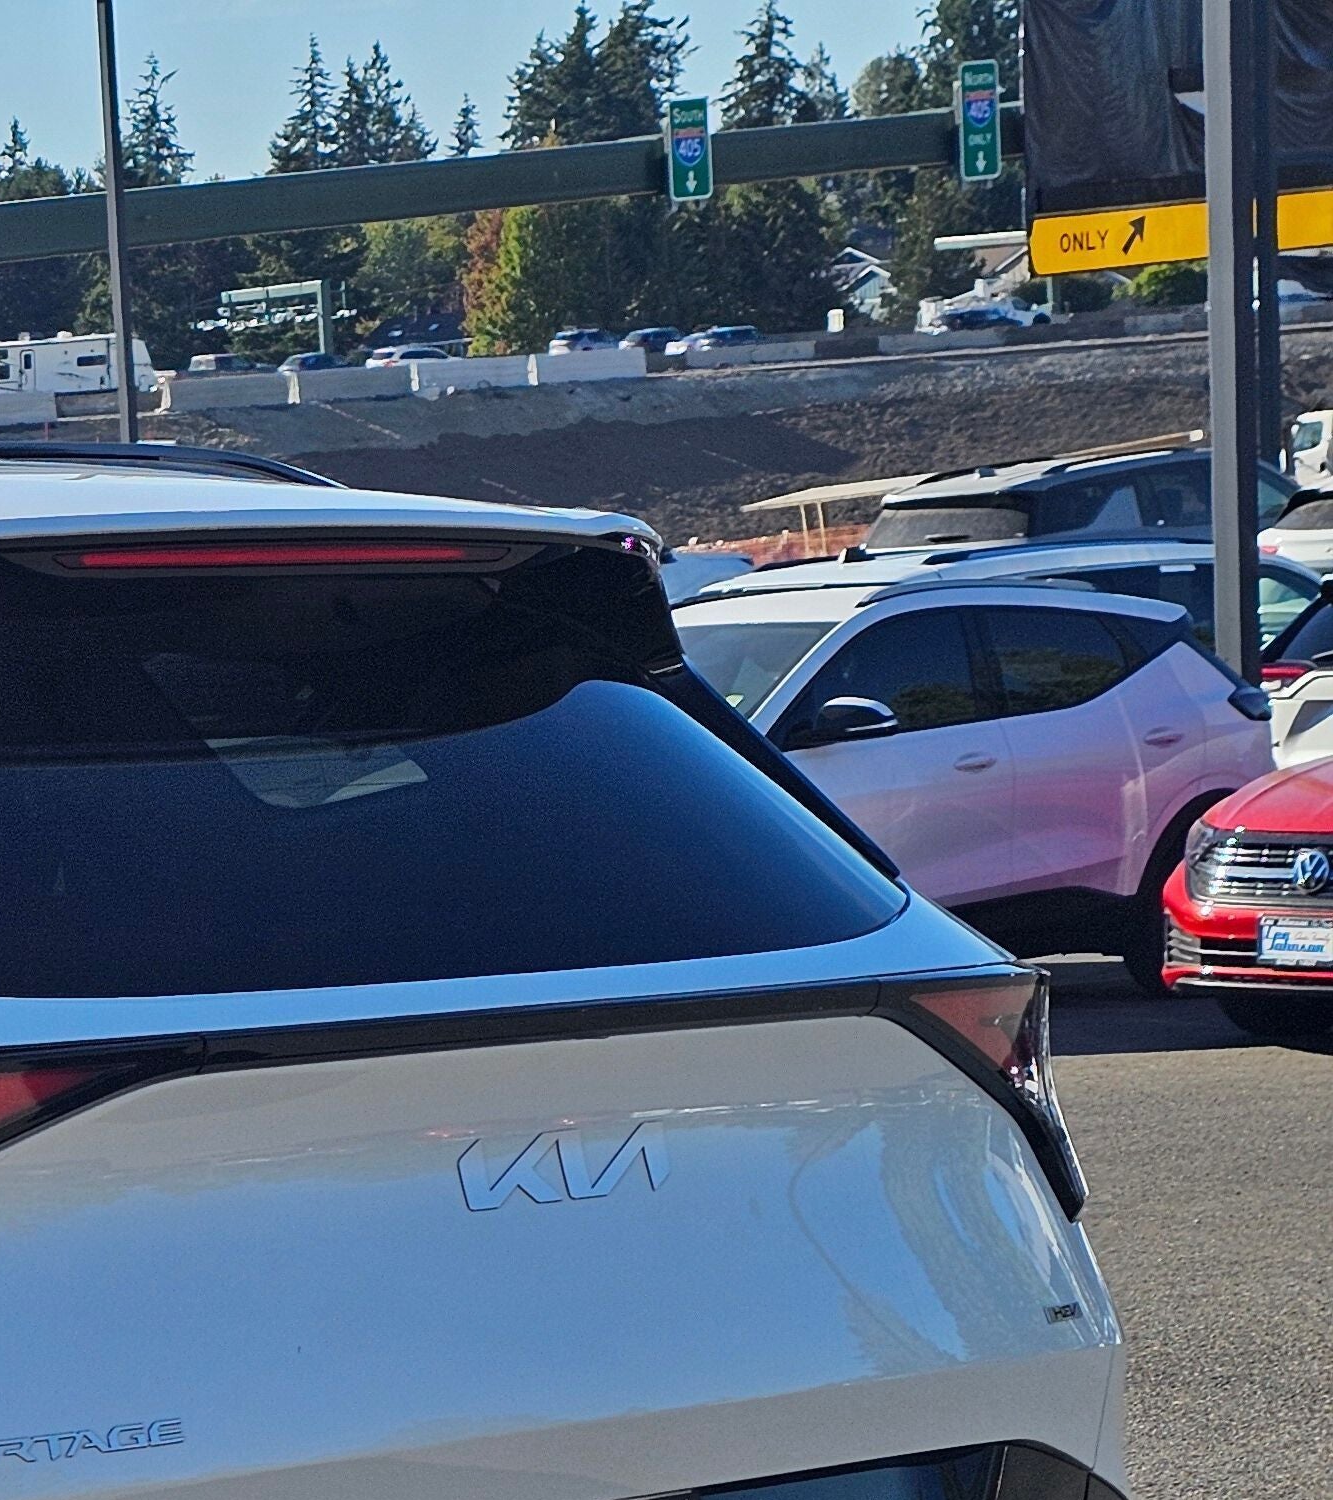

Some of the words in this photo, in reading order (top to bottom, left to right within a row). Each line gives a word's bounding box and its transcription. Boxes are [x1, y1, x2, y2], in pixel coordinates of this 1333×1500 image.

[678, 139, 701, 157] 405
[1059, 228, 1110, 253] ONLY
[457, 1120, 670, 1212] KIA
